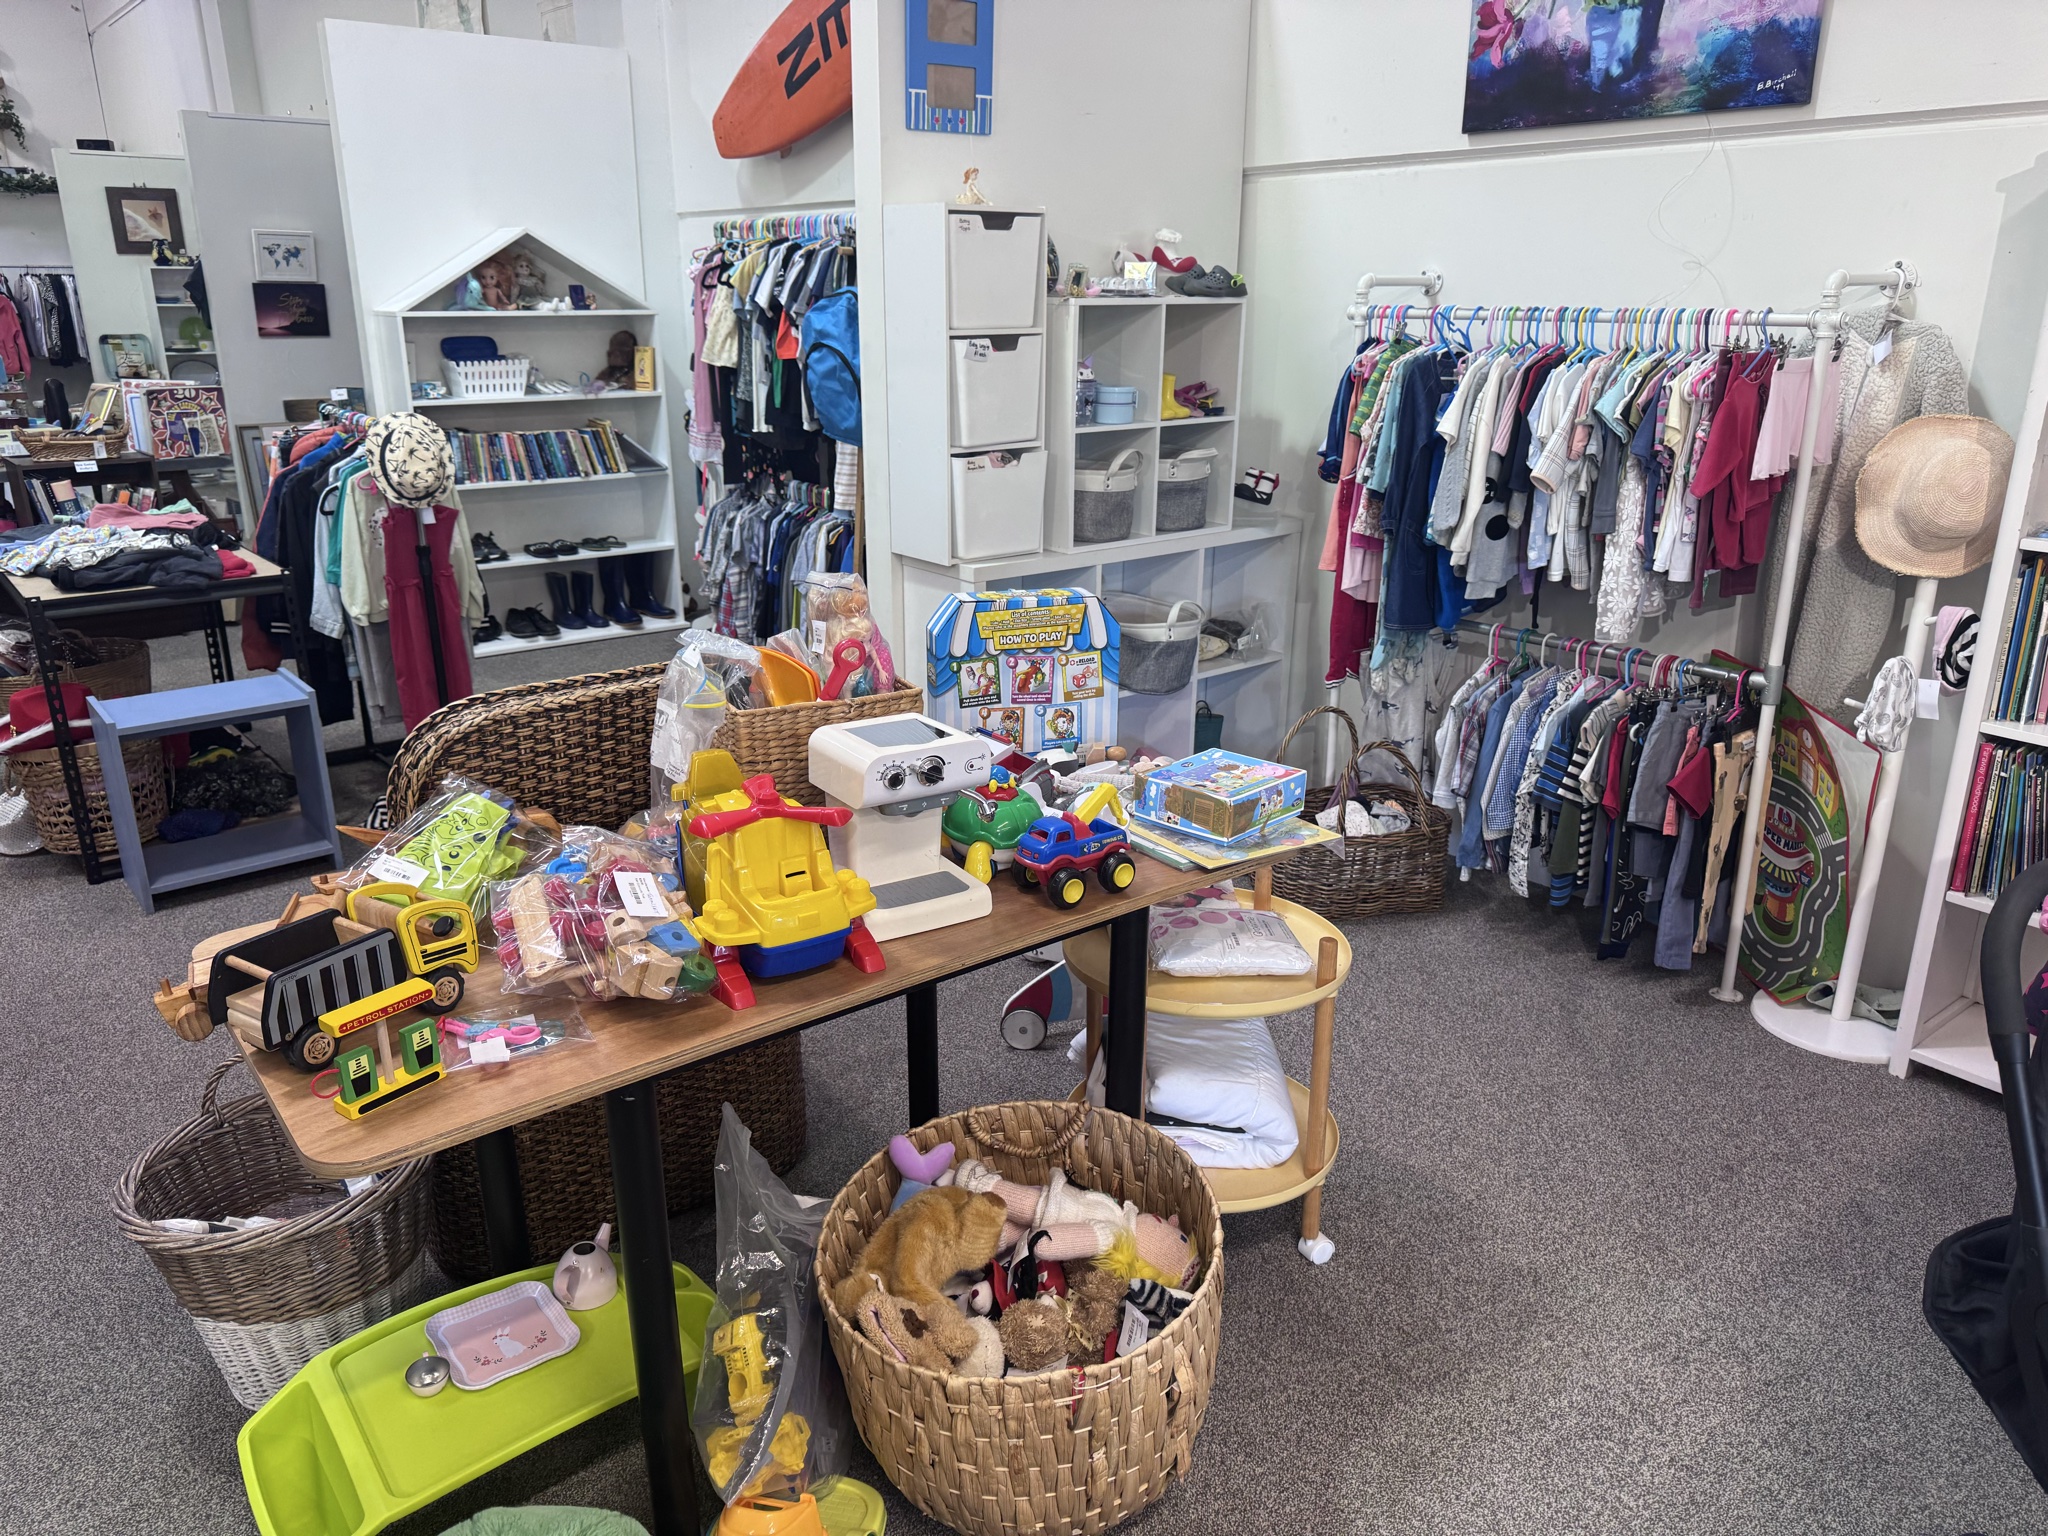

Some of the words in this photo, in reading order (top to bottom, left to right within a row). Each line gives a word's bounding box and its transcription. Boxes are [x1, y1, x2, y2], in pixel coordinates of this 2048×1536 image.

[999, 634, 1022, 645] HOW
[1024, 634, 1036, 644] TO
[1039, 632, 1062, 642] PLAY
[1978, 745, 1992, 776] Faraway
[1971, 775, 1985, 814] Childhoods
[346, 1010, 385, 1030] PETROL
[387, 993, 425, 1012] STATION
